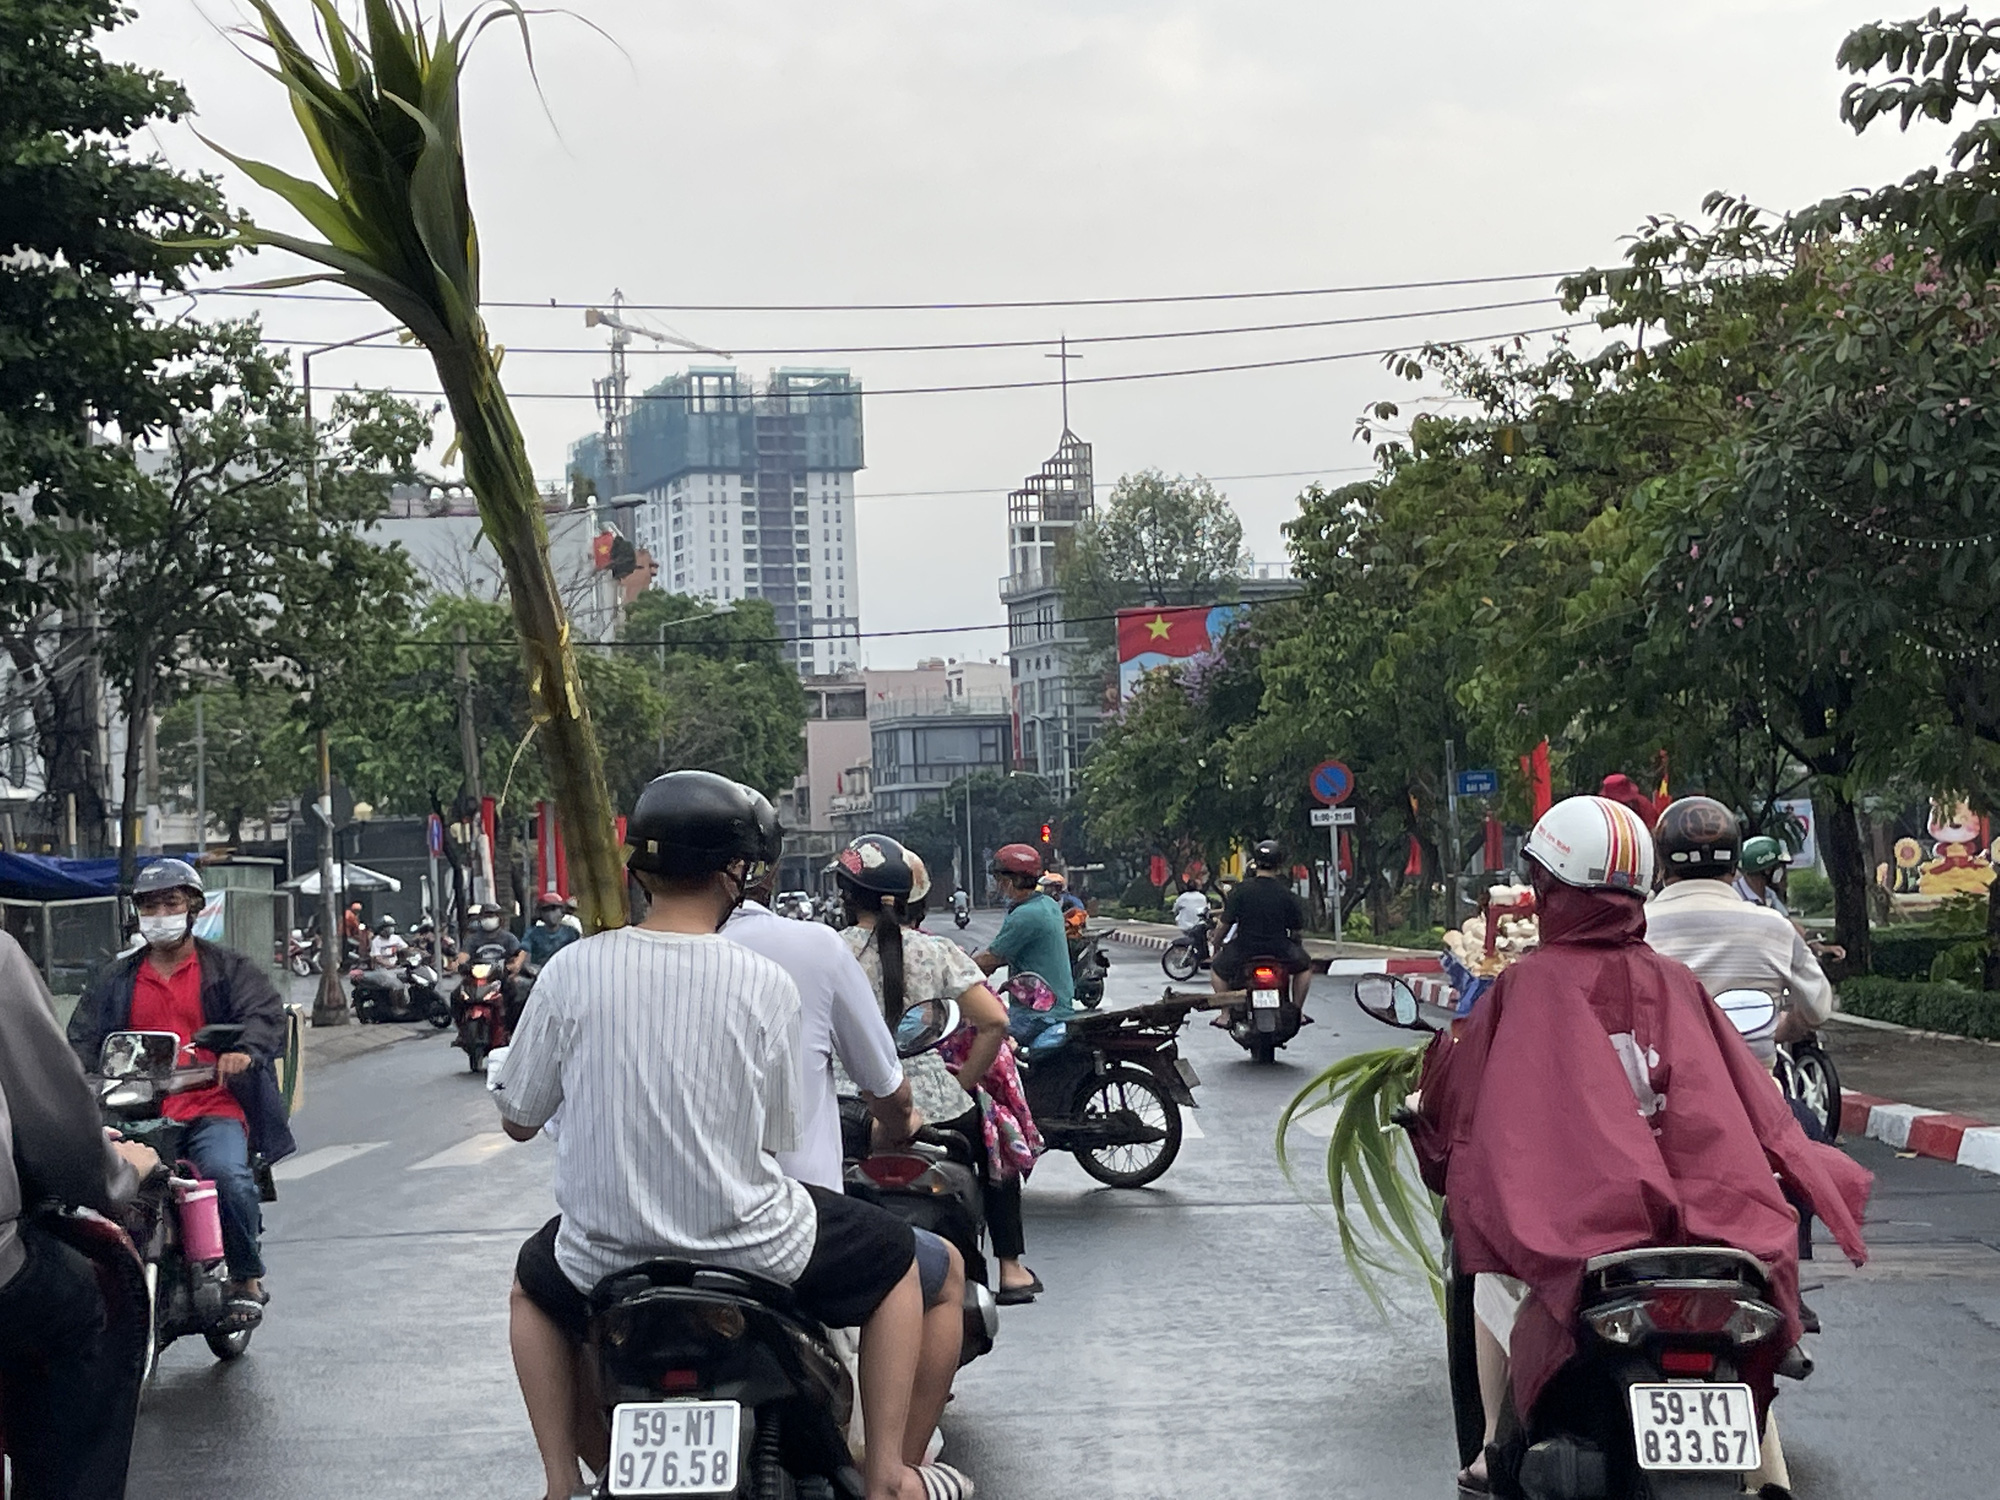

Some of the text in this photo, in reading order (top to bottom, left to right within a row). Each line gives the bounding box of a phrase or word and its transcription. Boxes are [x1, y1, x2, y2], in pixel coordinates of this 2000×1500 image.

[1650, 1391, 1731, 1426] 59-K1
[633, 1410, 715, 1447] 59-N1
[1644, 1429, 1747, 1464] 833.67
[619, 1450, 728, 1488] 976.58
